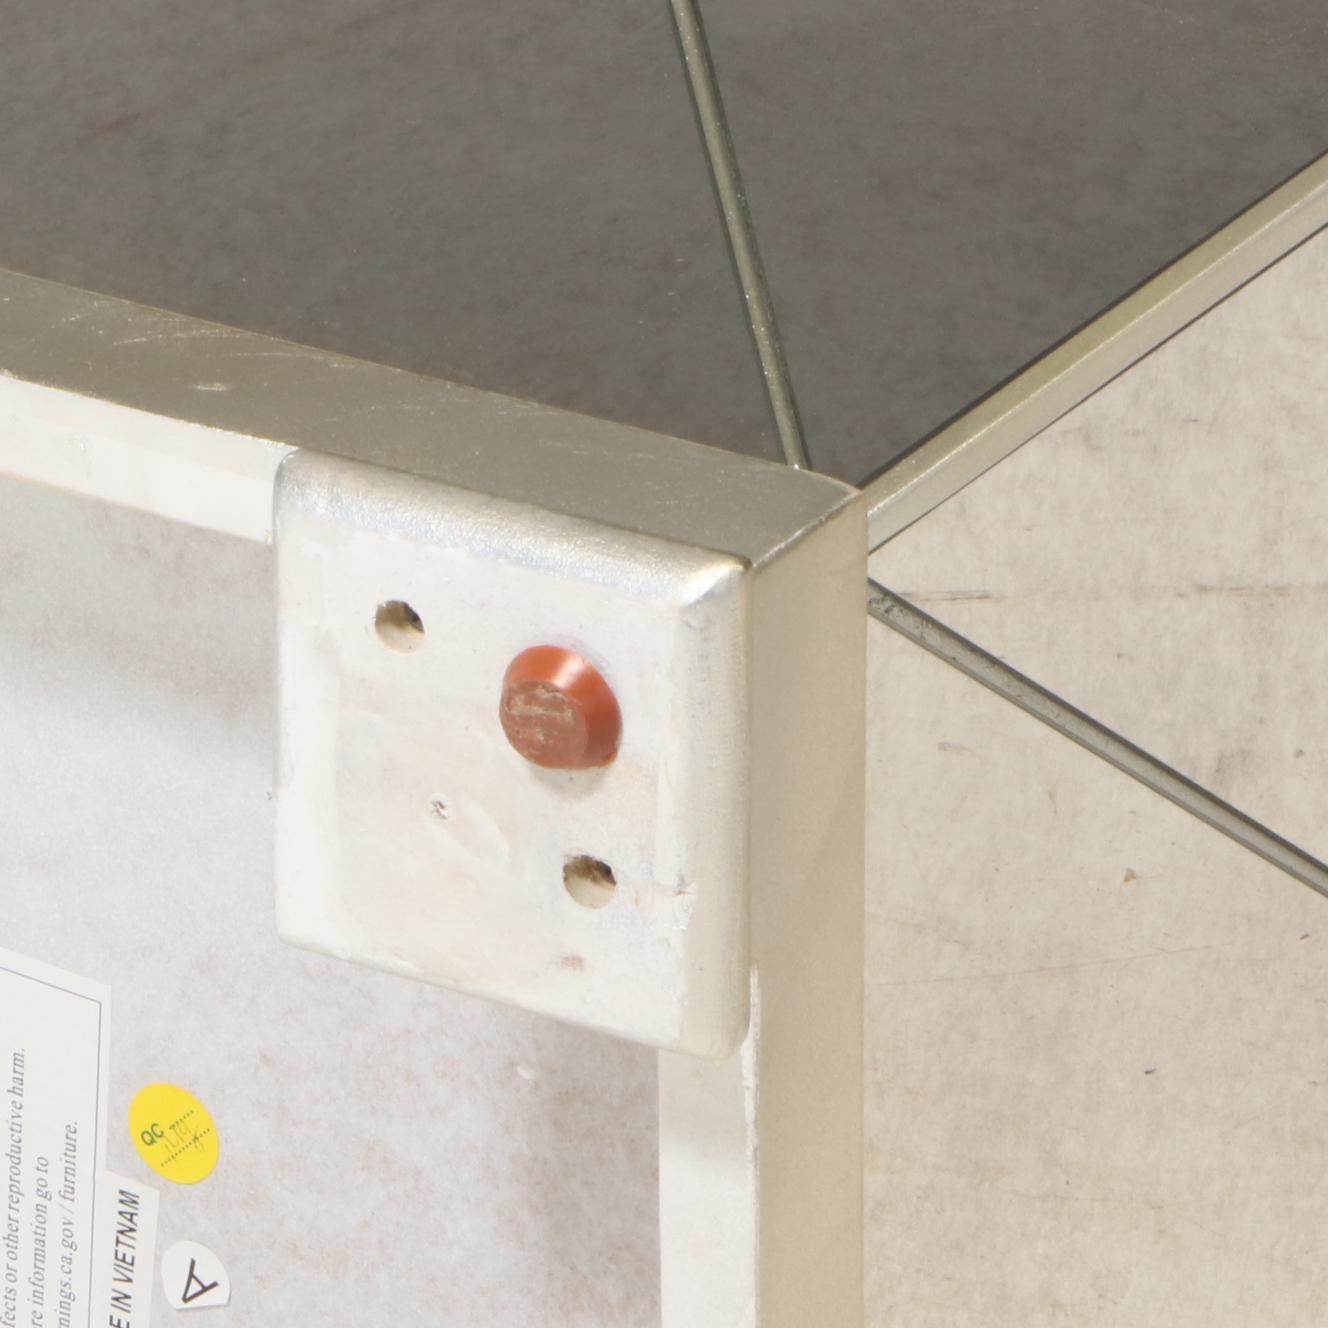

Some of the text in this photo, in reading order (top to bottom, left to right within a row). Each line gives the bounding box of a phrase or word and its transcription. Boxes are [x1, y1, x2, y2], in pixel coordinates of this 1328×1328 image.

[7, 1048, 26, 1097] harm.
[4, 1100, 24, 1212] reproductive
[141, 1123, 164, 1146] QC
[34, 1156, 48, 1173] to
[60, 1121, 78, 1203] furniture.
[35, 1177, 52, 1200] go
[2, 1214, 20, 1261] other
[27, 1204, 47, 1307] information
[113, 1189, 140, 1284] VIETNAM
[4, 1264, 18, 1283] or
[182, 1258, 219, 1303] A
[110, 1288, 132, 1314] IN
